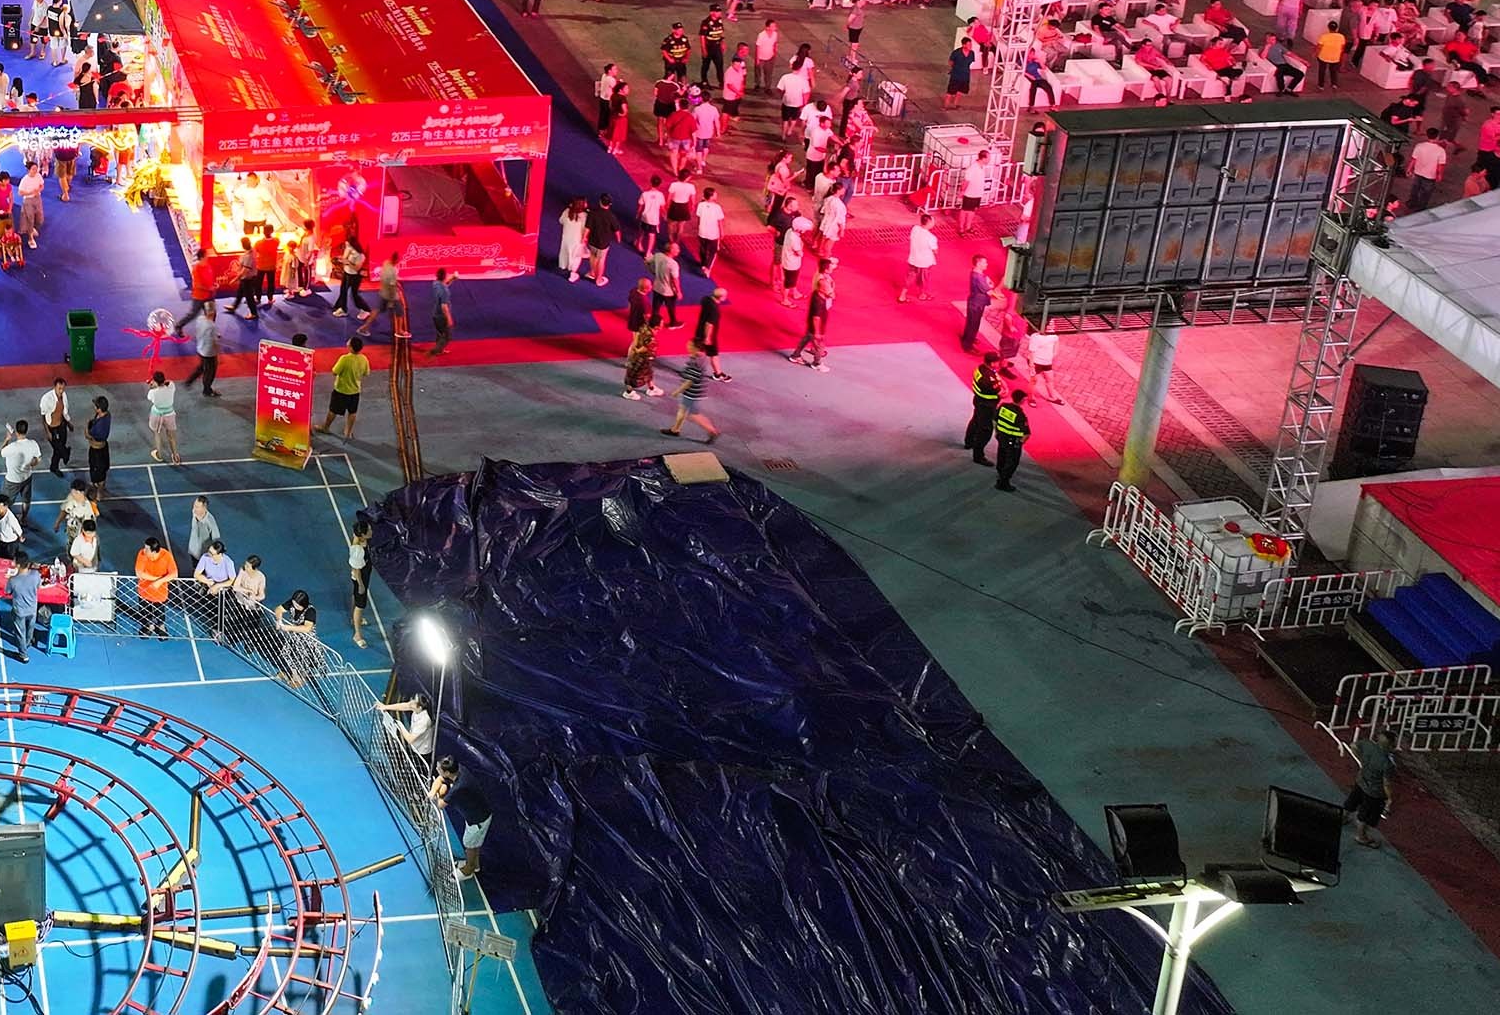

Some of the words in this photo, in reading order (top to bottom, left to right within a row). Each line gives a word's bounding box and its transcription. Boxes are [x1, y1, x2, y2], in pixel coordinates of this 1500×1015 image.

[218, 133, 361, 150] 2025三角生鱼美食文化嘉年华
[391, 125, 532, 143] 2025三角生鱼美食文化嘉年华
[1138, 536, 1166, 567] 三角公安
[1312, 594, 1353, 606] 三角公安
[1416, 719, 1464, 728] 三角公安
